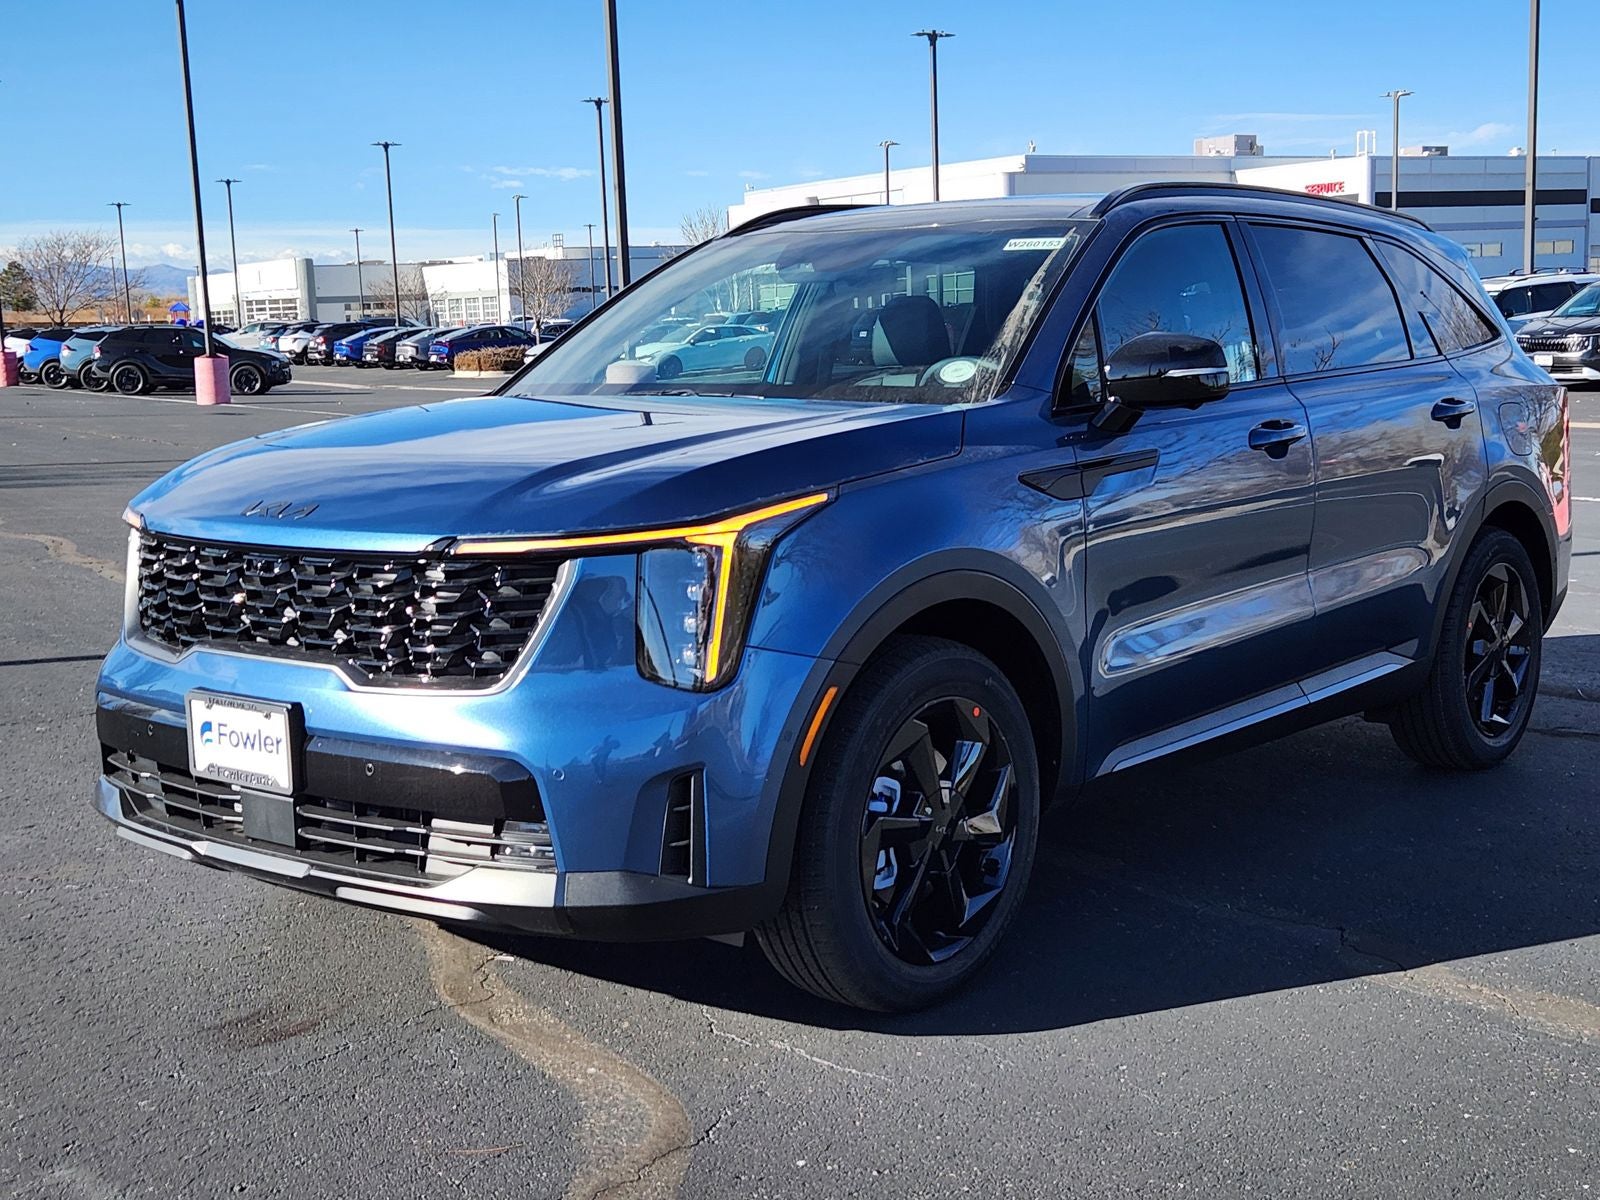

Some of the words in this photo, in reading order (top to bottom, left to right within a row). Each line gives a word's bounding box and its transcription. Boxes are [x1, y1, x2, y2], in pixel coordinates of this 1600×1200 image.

[1305, 181, 1345, 194] SERVICE
[1008, 240, 1062, 248] W260153
[217, 722, 282, 755] Fowler
